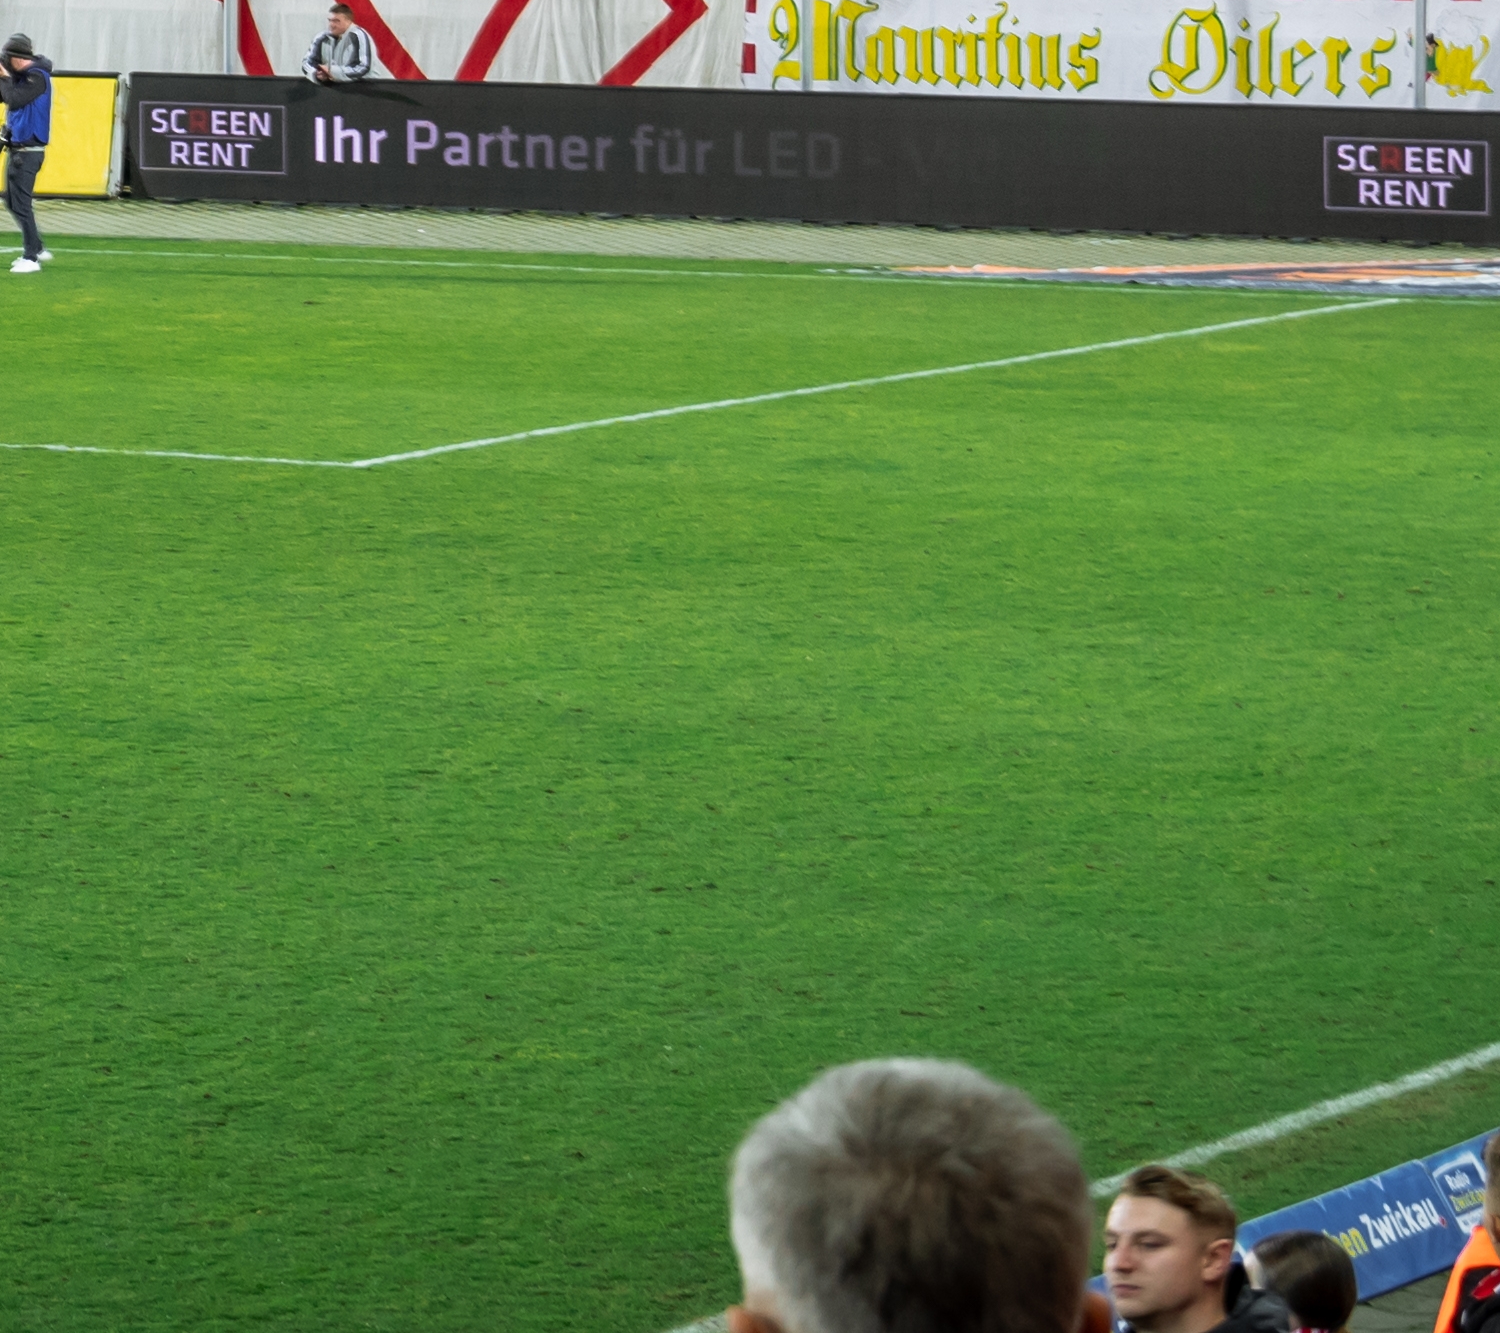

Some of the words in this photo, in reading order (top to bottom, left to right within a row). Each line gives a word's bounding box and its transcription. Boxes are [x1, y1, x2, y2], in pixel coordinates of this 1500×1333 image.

[150, 107, 271, 137] SCREEN
[169, 140, 254, 168] RENT
[314, 116, 388, 165] Ihr
[405, 118, 604, 175] Partner
[630, 124, 712, 176] für
[1337, 141, 1473, 176] SCREEN
[1358, 178, 1453, 208] RENT
[1359, 1195, 1441, 1250] Zwickau
